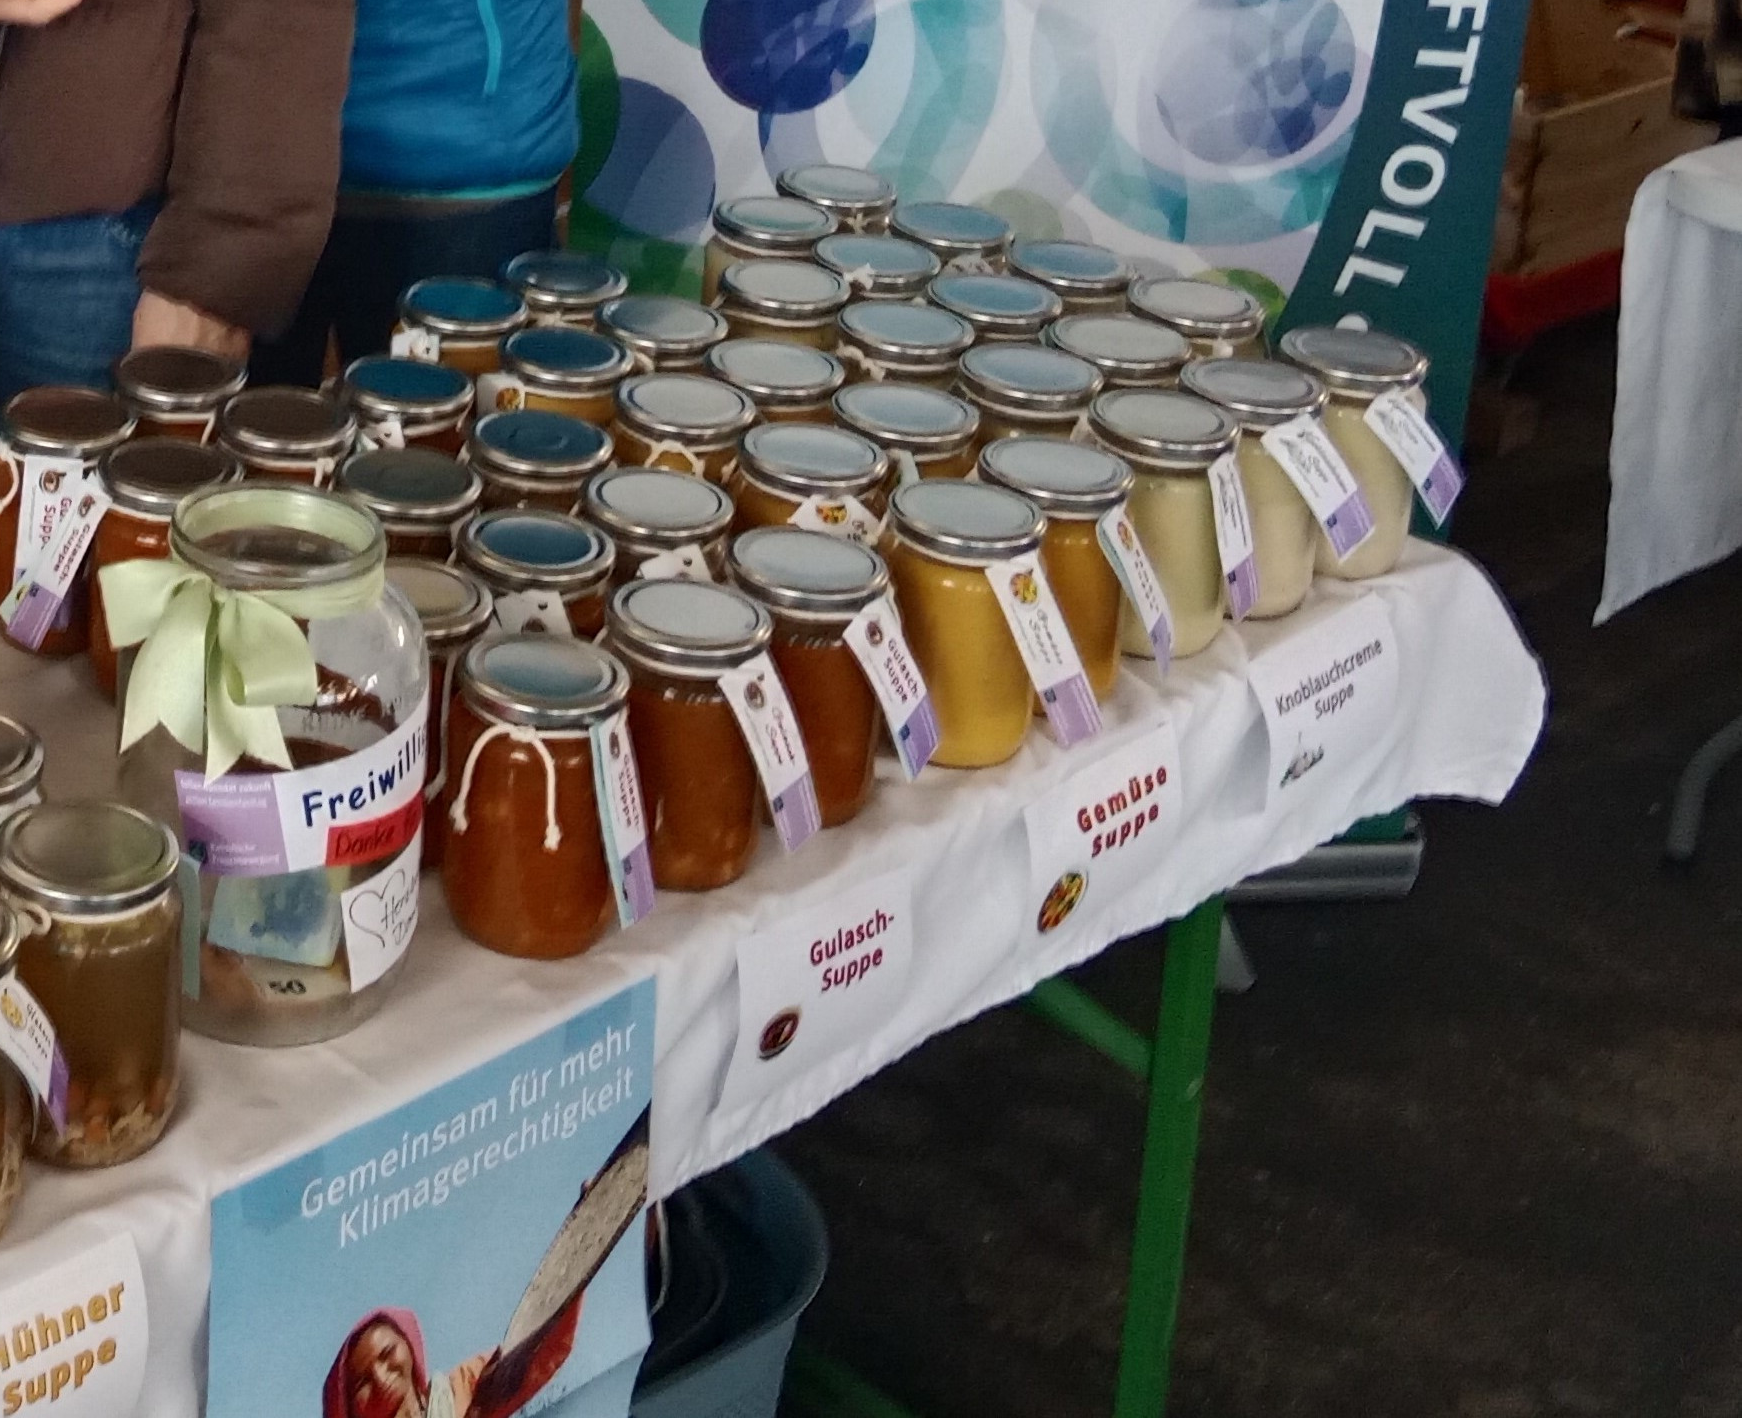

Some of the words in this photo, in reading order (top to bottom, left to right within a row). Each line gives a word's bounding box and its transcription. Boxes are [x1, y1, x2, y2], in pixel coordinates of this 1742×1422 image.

[1275, 638, 1383, 716] Knoblauchcreme
[1314, 683, 1354, 719] Suppe
[1076, 765, 1167, 833] Gemüse
[1091, 804, 1159, 858] Suppe
[810, 909, 895, 966] Gulasch-
[821, 947, 883, 993] Suppe
[300, 1095, 498, 1219] Gemeinsam
[508, 1068, 552, 1113] für
[561, 1021, 637, 1089] mehr
[339, 1067, 634, 1249] Klimagerechtigkeit
[2, 1337, 117, 1418] Suppe
